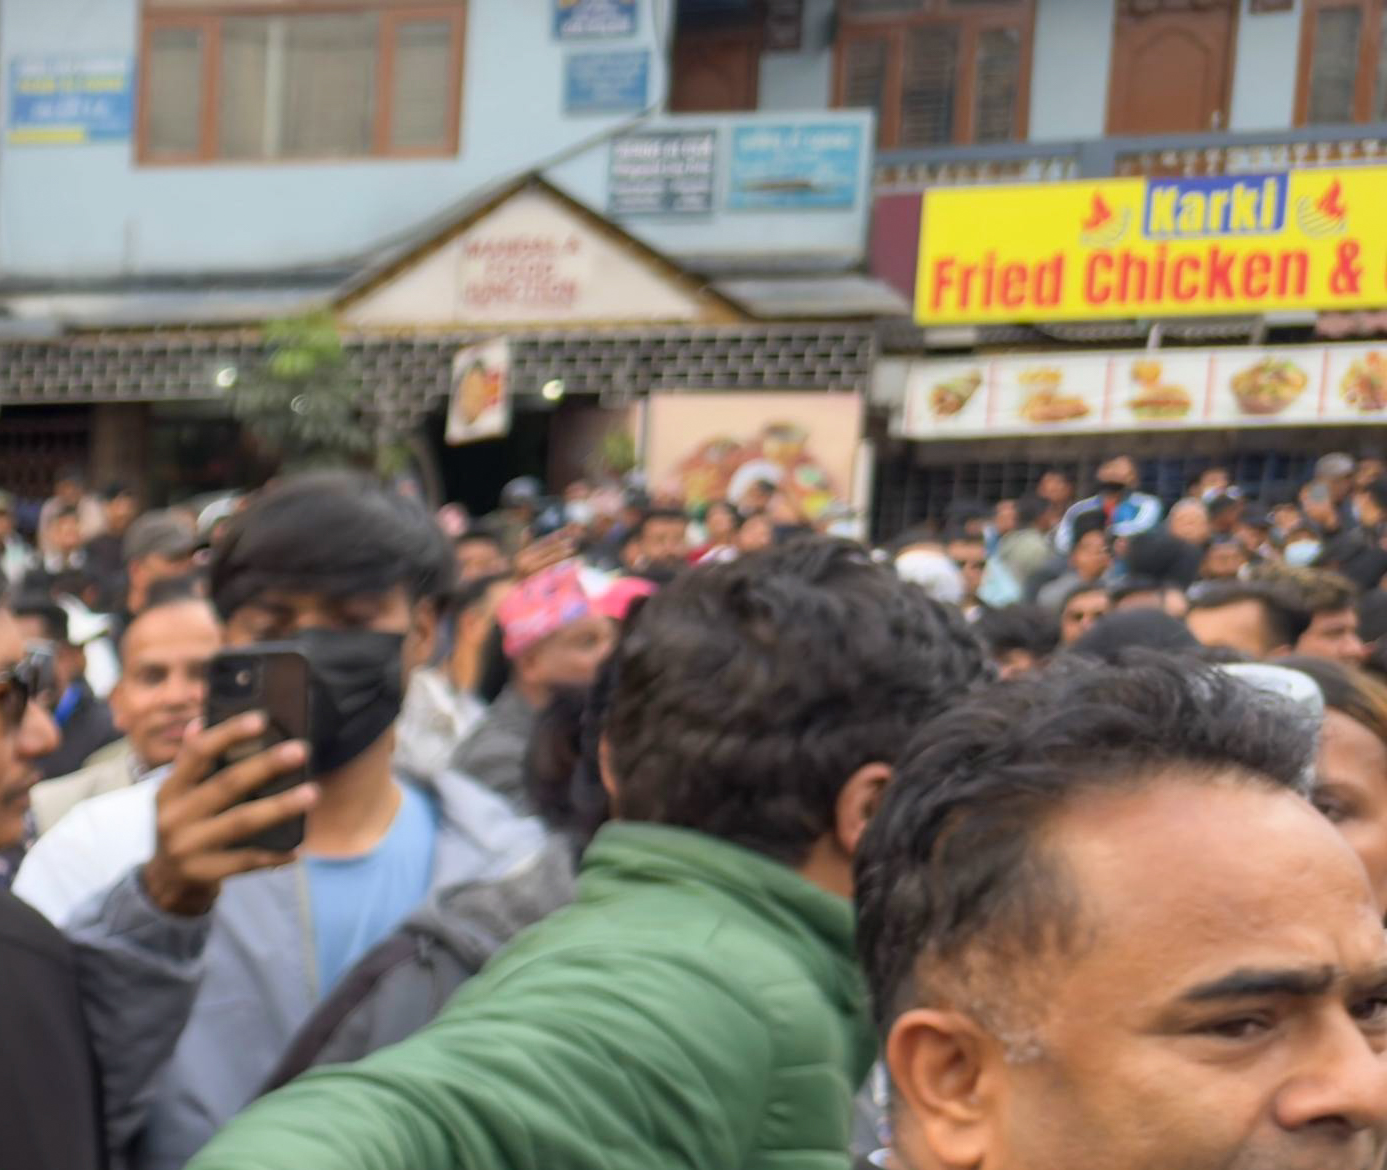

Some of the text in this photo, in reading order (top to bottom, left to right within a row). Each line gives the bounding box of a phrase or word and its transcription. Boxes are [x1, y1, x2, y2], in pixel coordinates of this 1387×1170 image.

[1148, 177, 1277, 234] Karki
[930, 249, 1065, 312] Fried
[1082, 240, 1309, 307] Chicken
[1327, 238, 1363, 297] &
